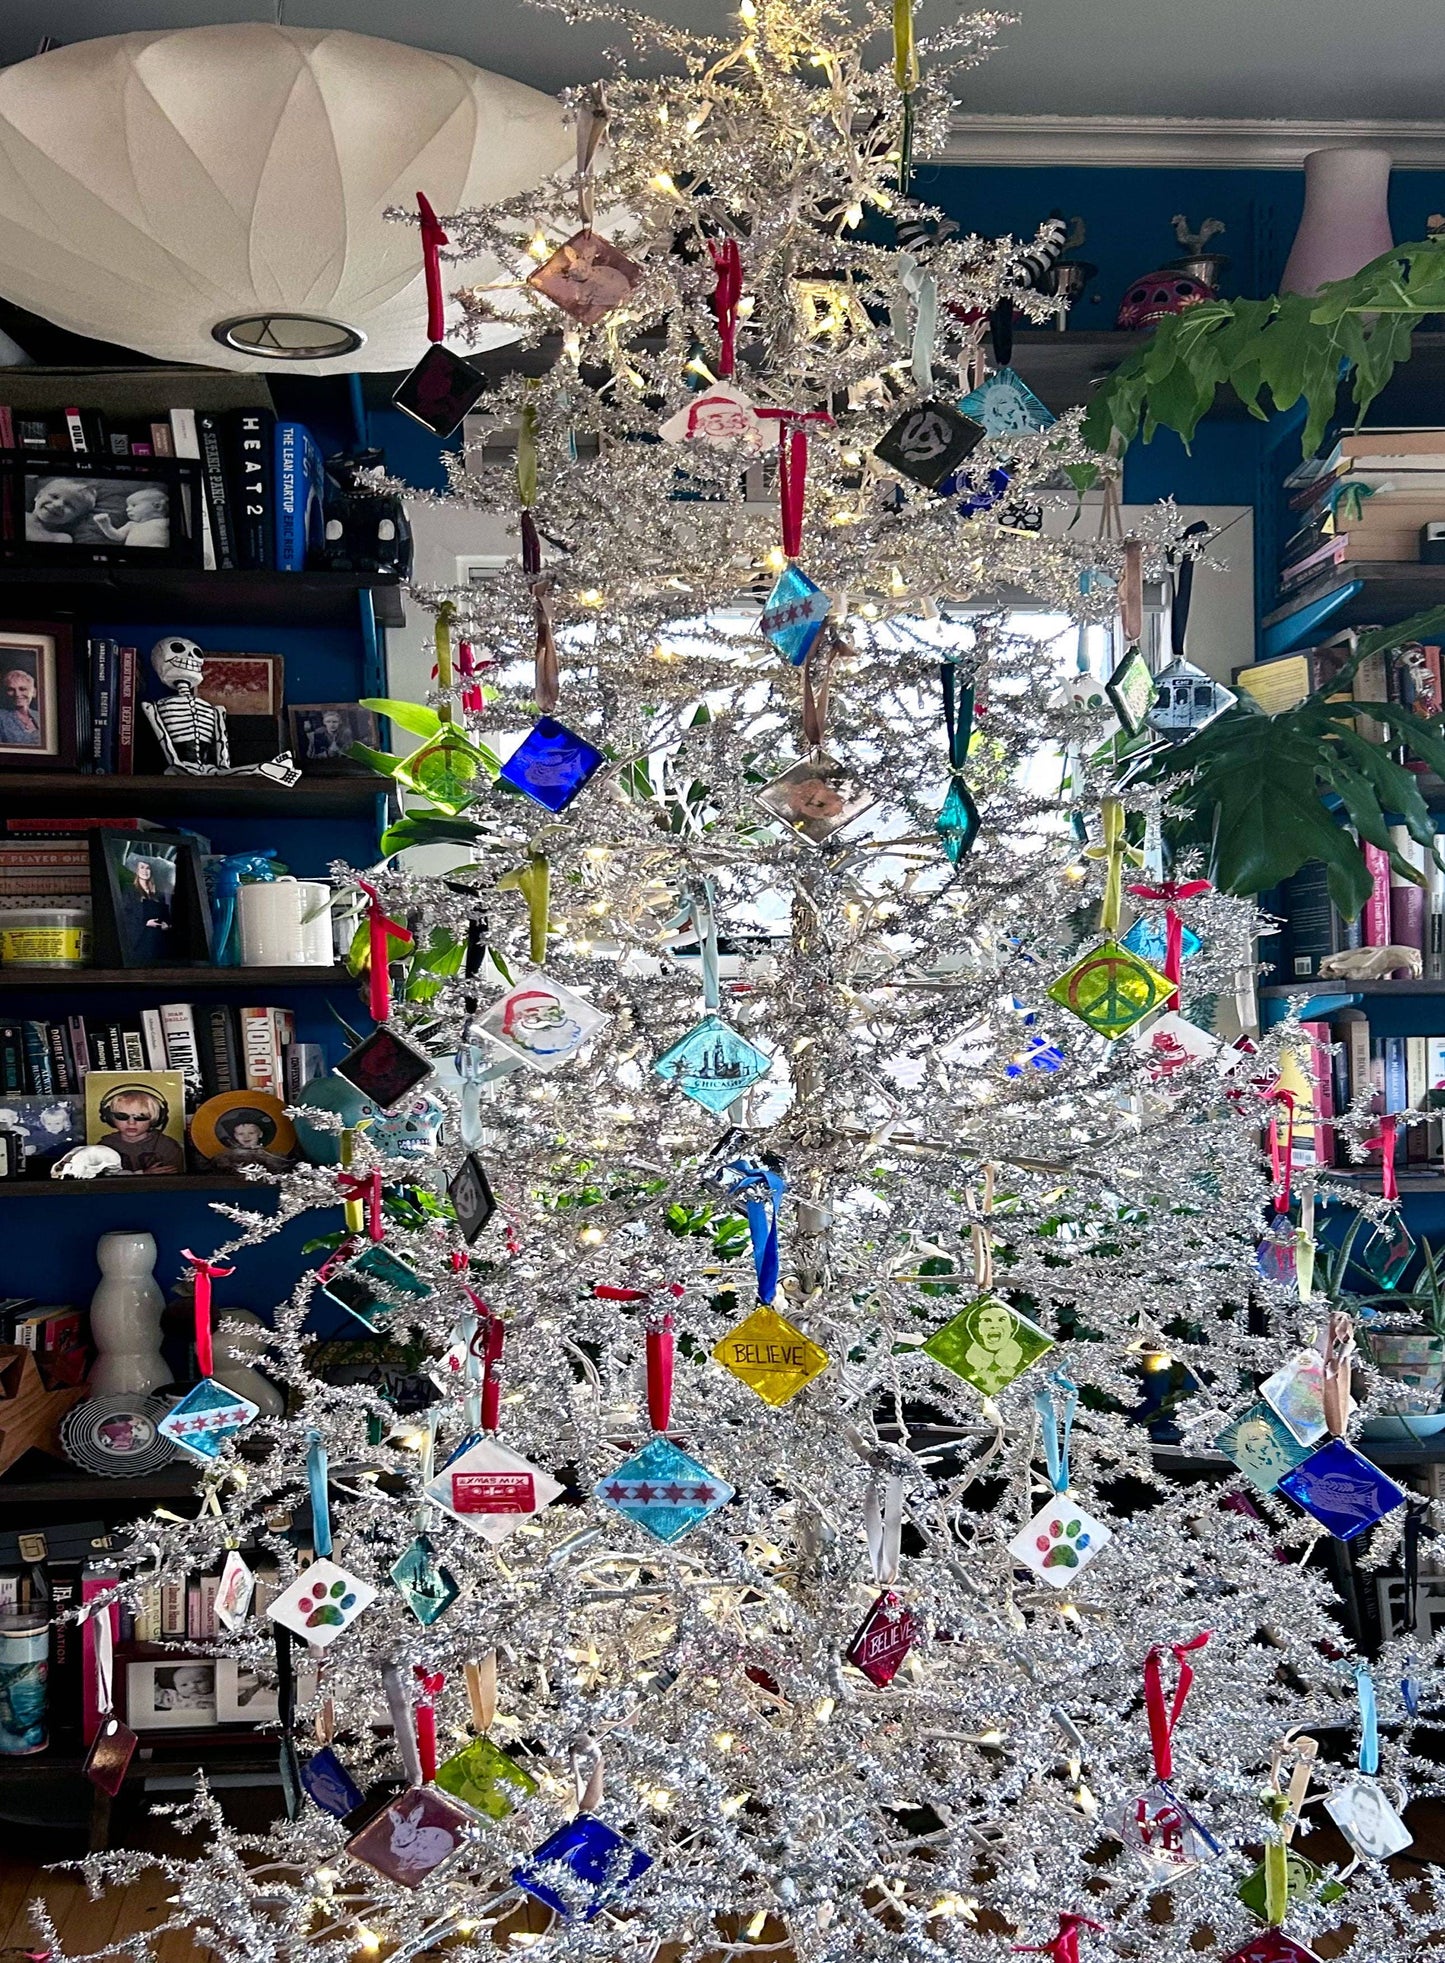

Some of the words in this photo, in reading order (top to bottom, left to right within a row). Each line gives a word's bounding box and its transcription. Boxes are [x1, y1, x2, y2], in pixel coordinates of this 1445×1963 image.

[72, 426, 83, 444] OUR
[283, 428, 294, 445] THE
[204, 433, 221, 473] SATANIC
[243, 418, 262, 493] HEAT
[283, 448, 293, 471] LEAN
[210, 476, 225, 504] PANIC
[283, 474, 294, 513] STARTUP
[247, 505, 263, 515] 2
[284, 515, 293, 536] ERIC
[284, 539, 293, 559] RIES
[122, 706, 131, 724] DEEP
[11, 855, 57, 863] PLAYER
[63, 855, 87, 863] ONE
[1374, 876, 1383, 900] Stories
[1375, 921, 1384, 932] the
[168, 1032, 190, 1042] EL
[246, 1017, 272, 1076] NORCO
[51, 1029, 64, 1060] DOUBLE
[58, 1064, 69, 1087] DOWN
[97, 1040, 106, 1065] Among
[169, 1045, 194, 1076] NARCO
[1357, 1057, 1365, 1076] BOOK
[31, 1065, 43, 1094] RUNNIN
[41, 1069, 52, 1094] ALWAY
[694, 1079, 742, 1087] CHICAGO
[1320, 1080, 1330, 1097] PULP
[1392, 1062, 1400, 1100] MURAKAMI
[733, 1344, 804, 1366] BELIEVE
[53, 1587, 72, 1602] IFA
[169, 1588, 180, 1603] Dance
[208, 1587, 214, 1595] AN
[169, 1611, 179, 1630] Havana
[56, 1604, 65, 1664] DINATION
[869, 1619, 913, 1657] BELIEVE
[1160, 1852, 1187, 1864] PARK
